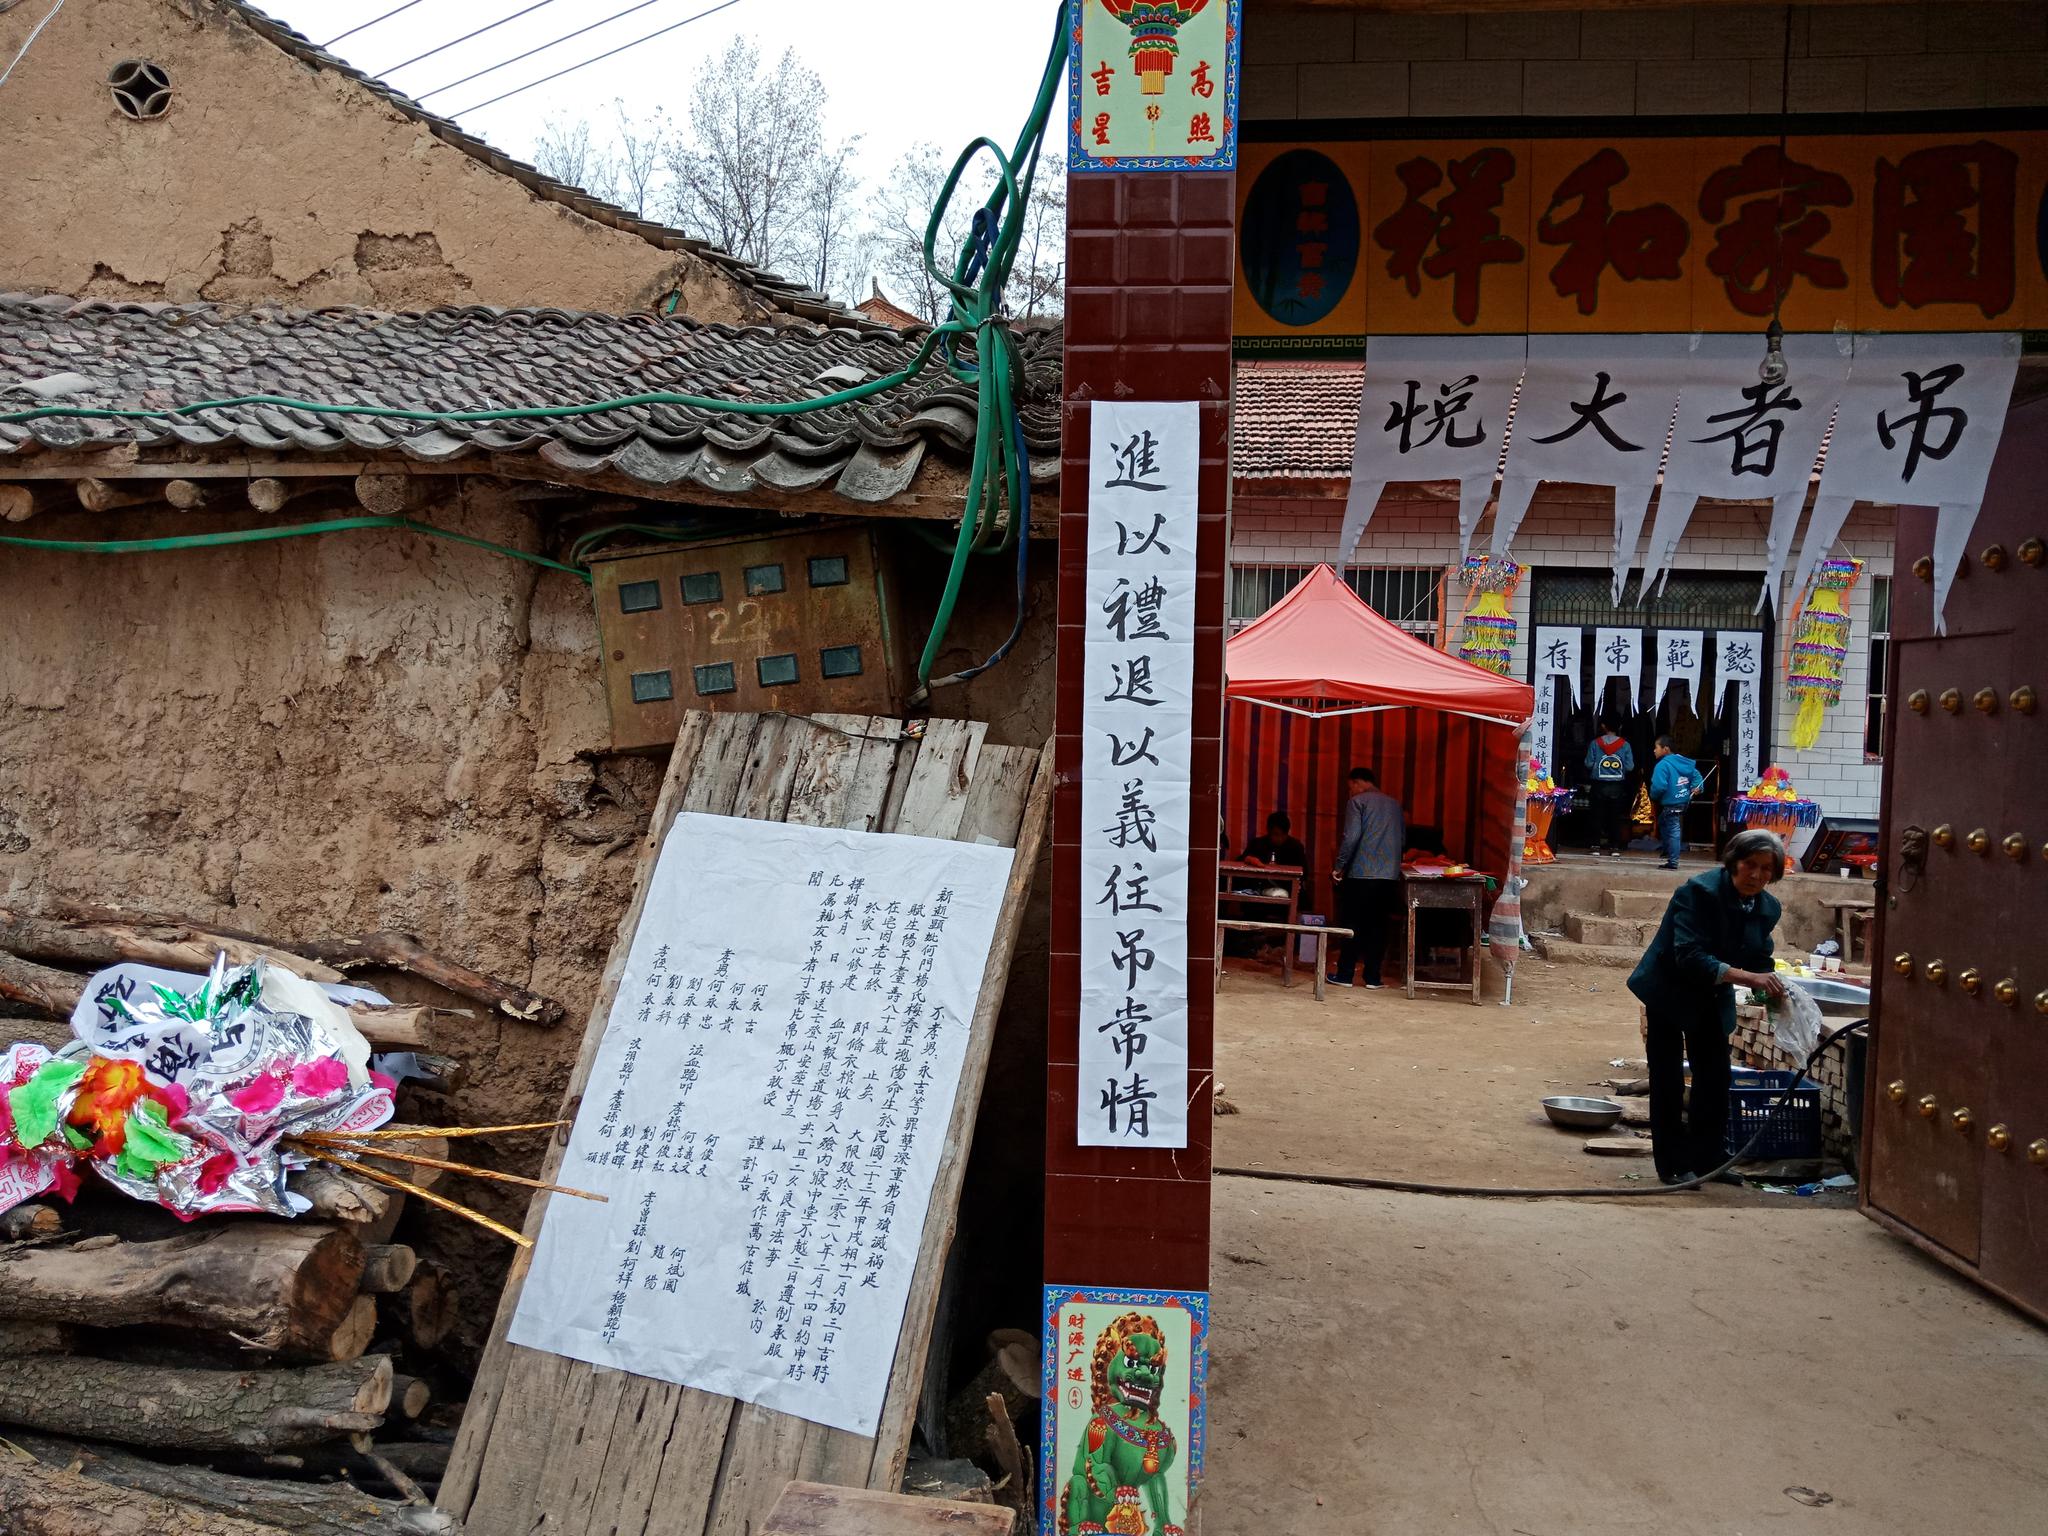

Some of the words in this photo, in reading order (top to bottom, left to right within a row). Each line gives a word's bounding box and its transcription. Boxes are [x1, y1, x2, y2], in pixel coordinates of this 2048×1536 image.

[1091, 60, 1116, 145] 吉星
[1187, 60, 1216, 145] 高照
[1096, 429, 1173, 1138] 進以禮退以義往吊常情
[829, 951, 840, 963] 日
[744, 983, 769, 1034] 何永吉
[770, 1137, 786, 1152] 山
[1065, 1312, 1087, 1383] 财源广进
